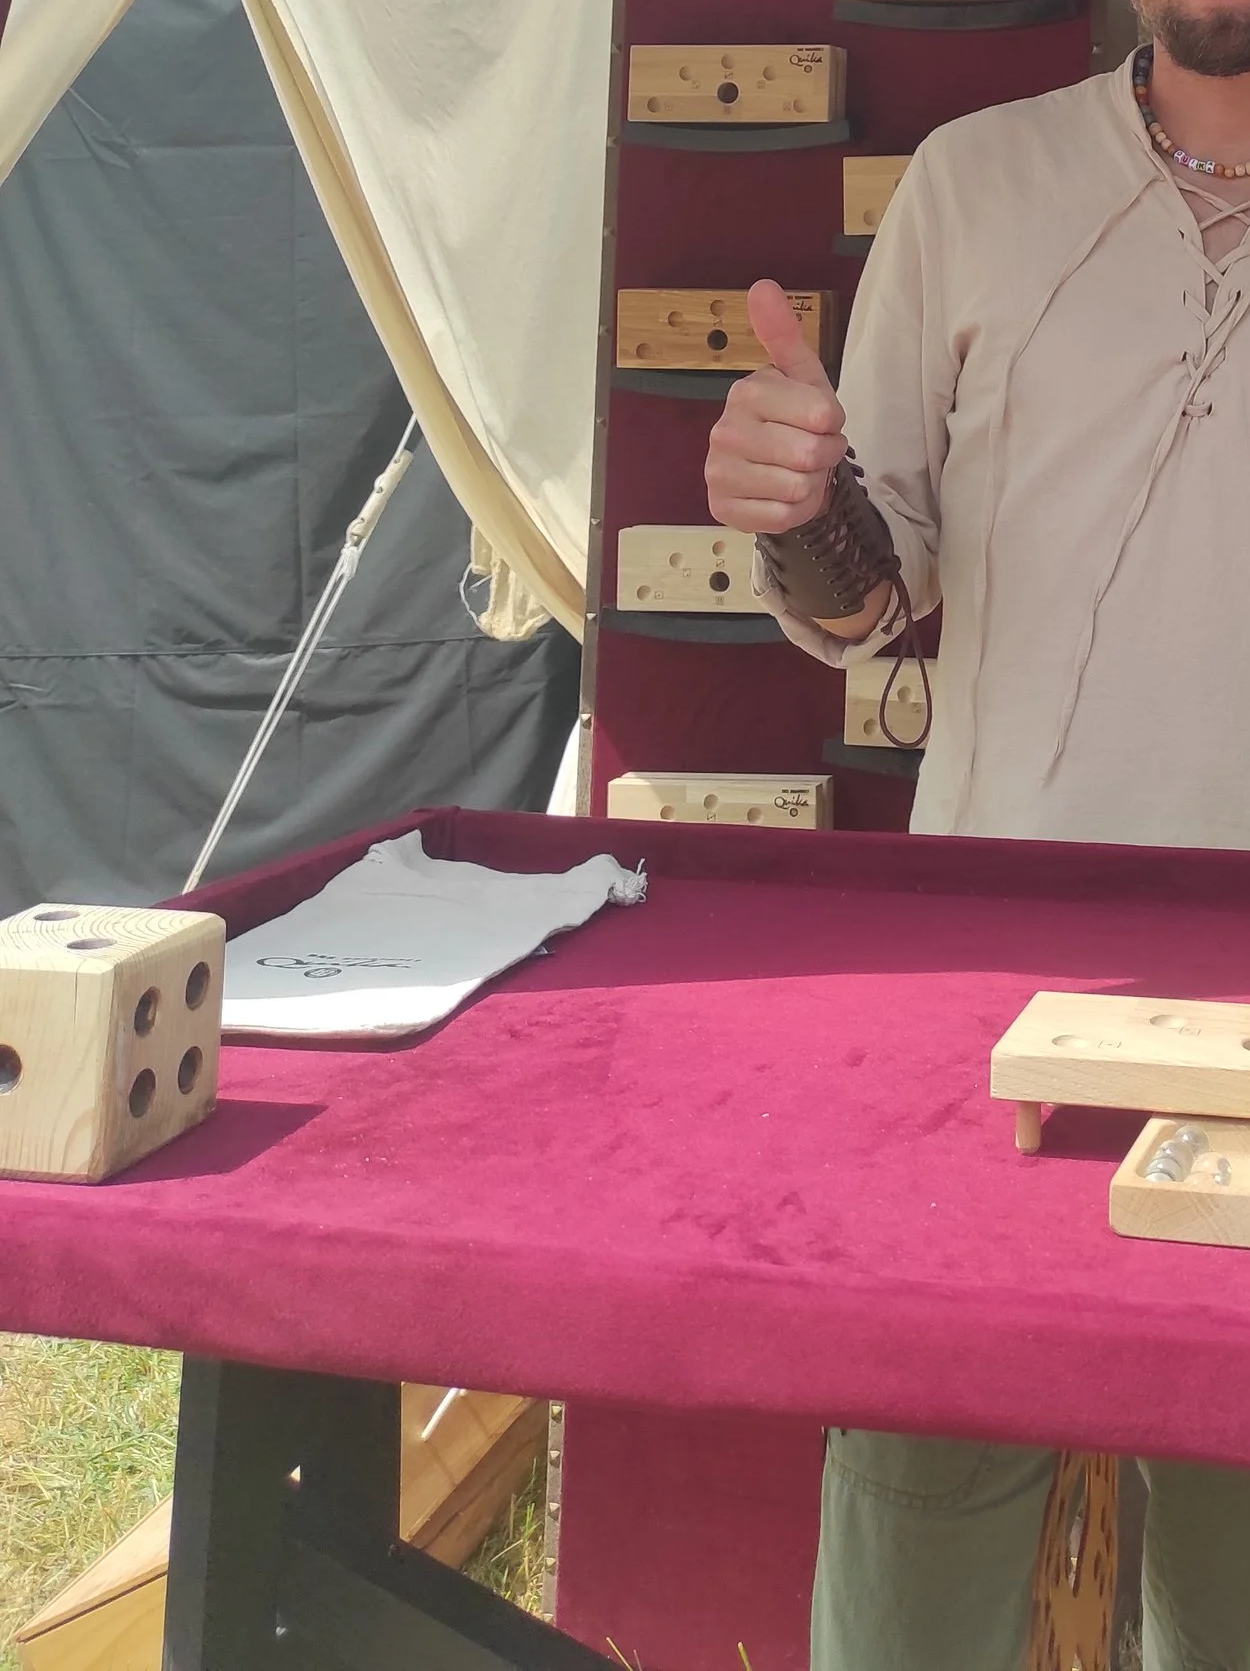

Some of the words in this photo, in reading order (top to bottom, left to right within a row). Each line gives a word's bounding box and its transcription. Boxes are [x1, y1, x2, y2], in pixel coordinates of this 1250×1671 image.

[789, 52, 823, 66] Quika
[1174, 150, 1214, 173] QUIKA
[774, 794, 809, 810] Quika
